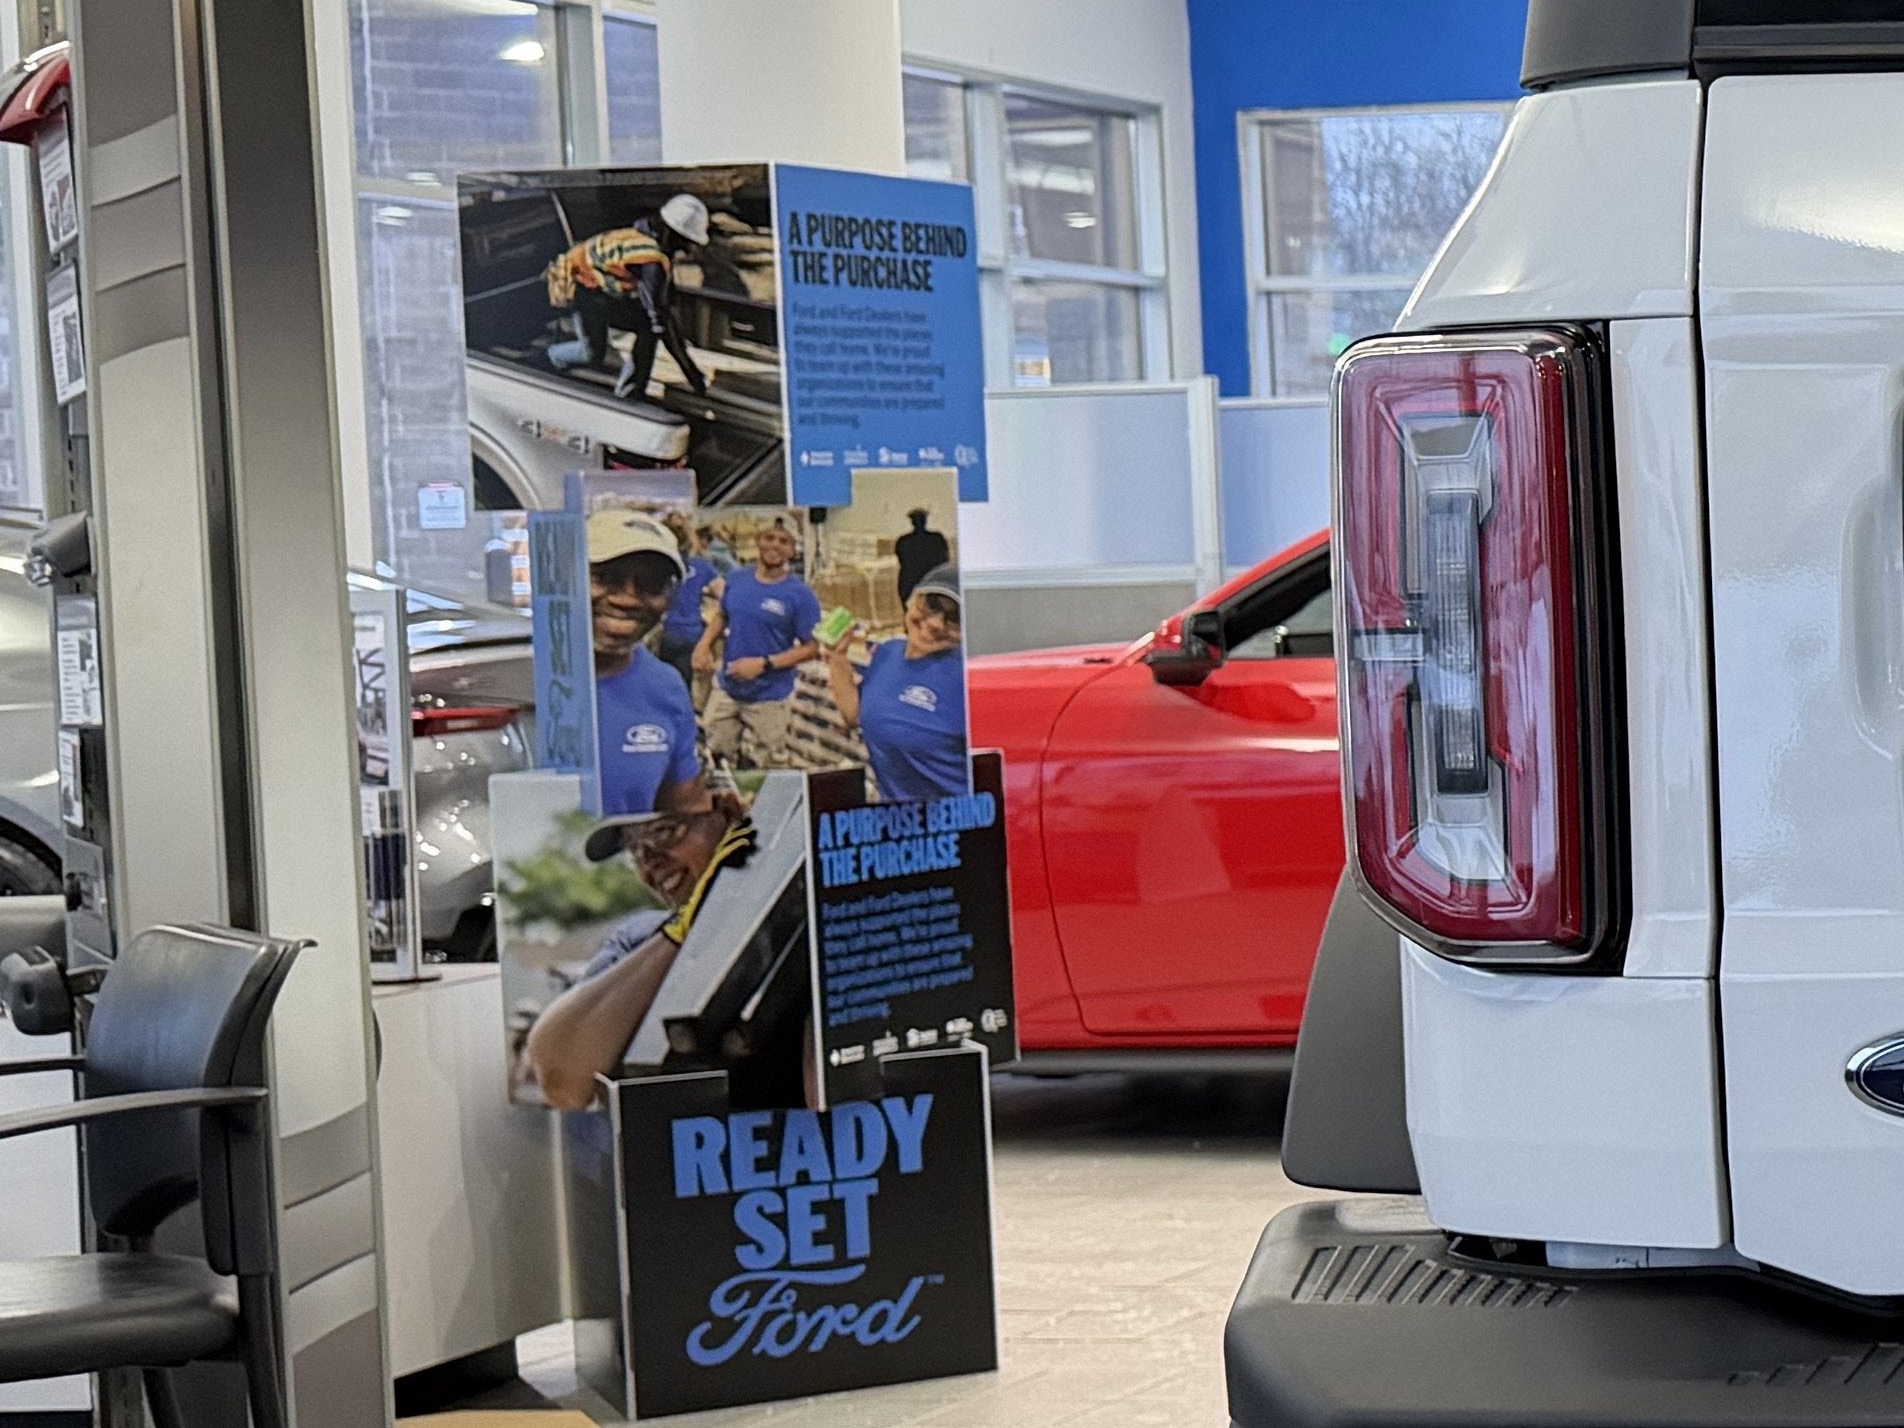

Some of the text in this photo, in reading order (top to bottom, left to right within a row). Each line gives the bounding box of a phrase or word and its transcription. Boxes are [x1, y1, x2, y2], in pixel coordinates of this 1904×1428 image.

[789, 211, 967, 258] A PURPOSE BEHIND
[789, 249, 934, 292] THE PURCHASE
[818, 791, 996, 849] A PURPOSE BEHIND
[818, 833, 962, 888] THE PURCHASE
[671, 1093, 933, 1199] READY
[734, 1176, 880, 1271] SET
[685, 1262, 926, 1367] Ford
